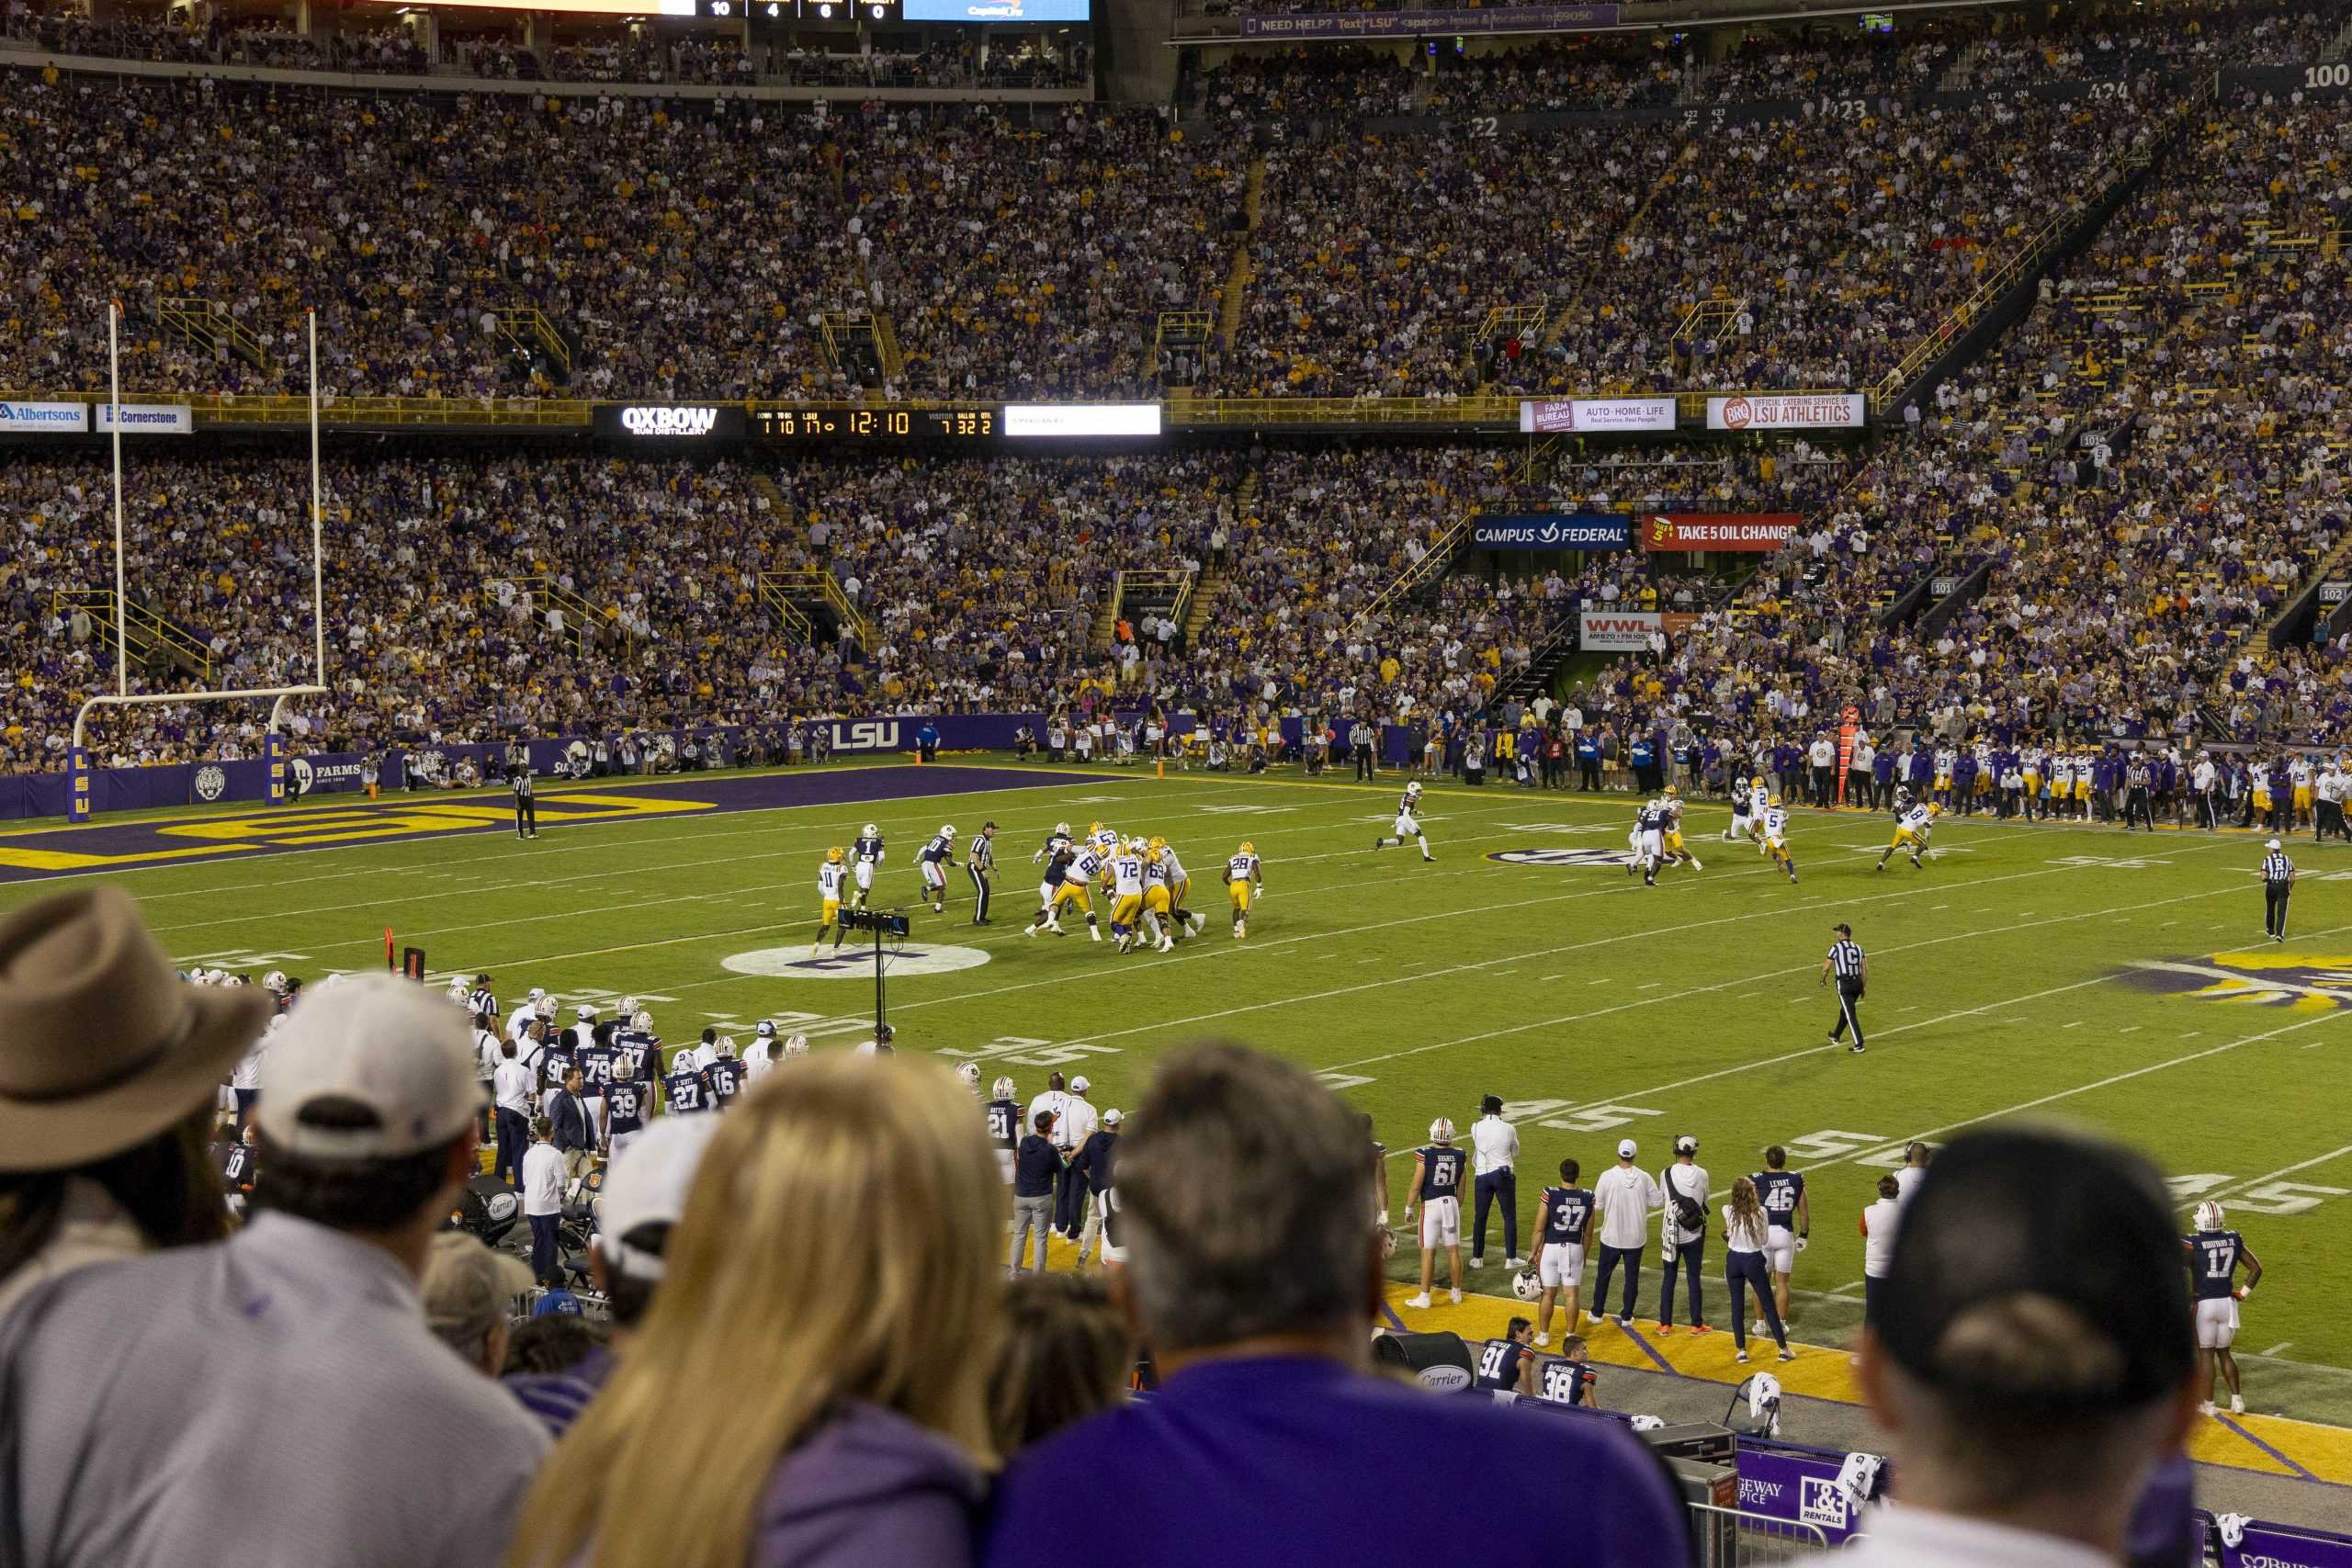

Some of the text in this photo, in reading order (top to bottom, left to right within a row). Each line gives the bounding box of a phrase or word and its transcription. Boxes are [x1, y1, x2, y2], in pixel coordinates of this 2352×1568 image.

[711, 2, 729, 16] 10
[767, 3, 779, 17] 4
[820, 4, 831, 18] 6
[872, 5, 884, 18] 0
[1261, 19, 1292, 31] NEED
[1295, 18, 1332, 30] HELP?
[1338, 18, 1363, 30] Text
[1400, 17, 1447, 30] <space>
[2305, 63, 2350, 88] 100
[1684, 109, 1698, 118] 422
[1711, 108, 1725, 118] 423
[1544, 402, 1568, 413] FARM
[1754, 396, 1849, 407] OFFICIAL CATERING SERVICE OF
[17, 407, 81, 422] Albertsons
[121, 412, 177, 424] Cornerstone
[622, 407, 717, 429] OXBOW
[1536, 410, 1570, 423] BUREAU
[1587, 406, 1665, 416] AUTO HOME LIFE
[1754, 405, 1850, 423] LSU ATHLETICS
[633, 426, 707, 435] RUM DISTILLERY
[781, 421, 794, 434] 10
[806, 421, 820, 434] 17
[942, 421, 950, 434] 7
[957, 421, 976, 434] 32
[981, 421, 990, 434] 2
[1475, 528, 1623, 542] CAMPUS FEDERAL
[1653, 531, 1664, 541] 5
[1677, 525, 1707, 540] TAKE
[1711, 525, 1717, 540] 5
[1720, 525, 1739, 540] OIL
[1936, 584, 1951, 594] 101
[2324, 590, 2342, 600] 102
[1587, 619, 1652, 633] WWL
[831, 722, 899, 750] LSU
[271, 742, 285, 798] LSU
[316, 764, 360, 778] FARMS
[75, 755, 89, 814] LSU
[1648, 809, 1660, 821] 91
[1769, 815, 1778, 828] 5
[1910, 809, 1924, 821] 8
[1100, 832, 1118, 846] 53
[1080, 855, 1100, 877] 66
[1120, 862, 1139, 878] 72
[1231, 857, 1248, 871] 28
[2274, 858, 2284, 872] R
[1149, 864, 1164, 879] 69
[825, 872, 833, 888] 11
[1846, 948, 1860, 965] C
[547, 1060, 571, 1084] 90
[585, 1060, 611, 1084] 79
[712, 1071, 734, 1097] 16
[673, 1083, 699, 1111] 27
[611, 1094, 637, 1119] 39
[988, 1114, 1010, 1139] 21
[1432, 1162, 1457, 1187] 61
[1765, 1186, 1795, 1212] 46
[491, 1199, 514, 1216] Carrier
[1554, 1204, 1587, 1233] 37
[2207, 1247, 2234, 1279] 17
[1478, 1346, 1505, 1380] 91
[1543, 1370, 1573, 1404] 38
[1804, 1510, 1842, 1524] RENTALS
